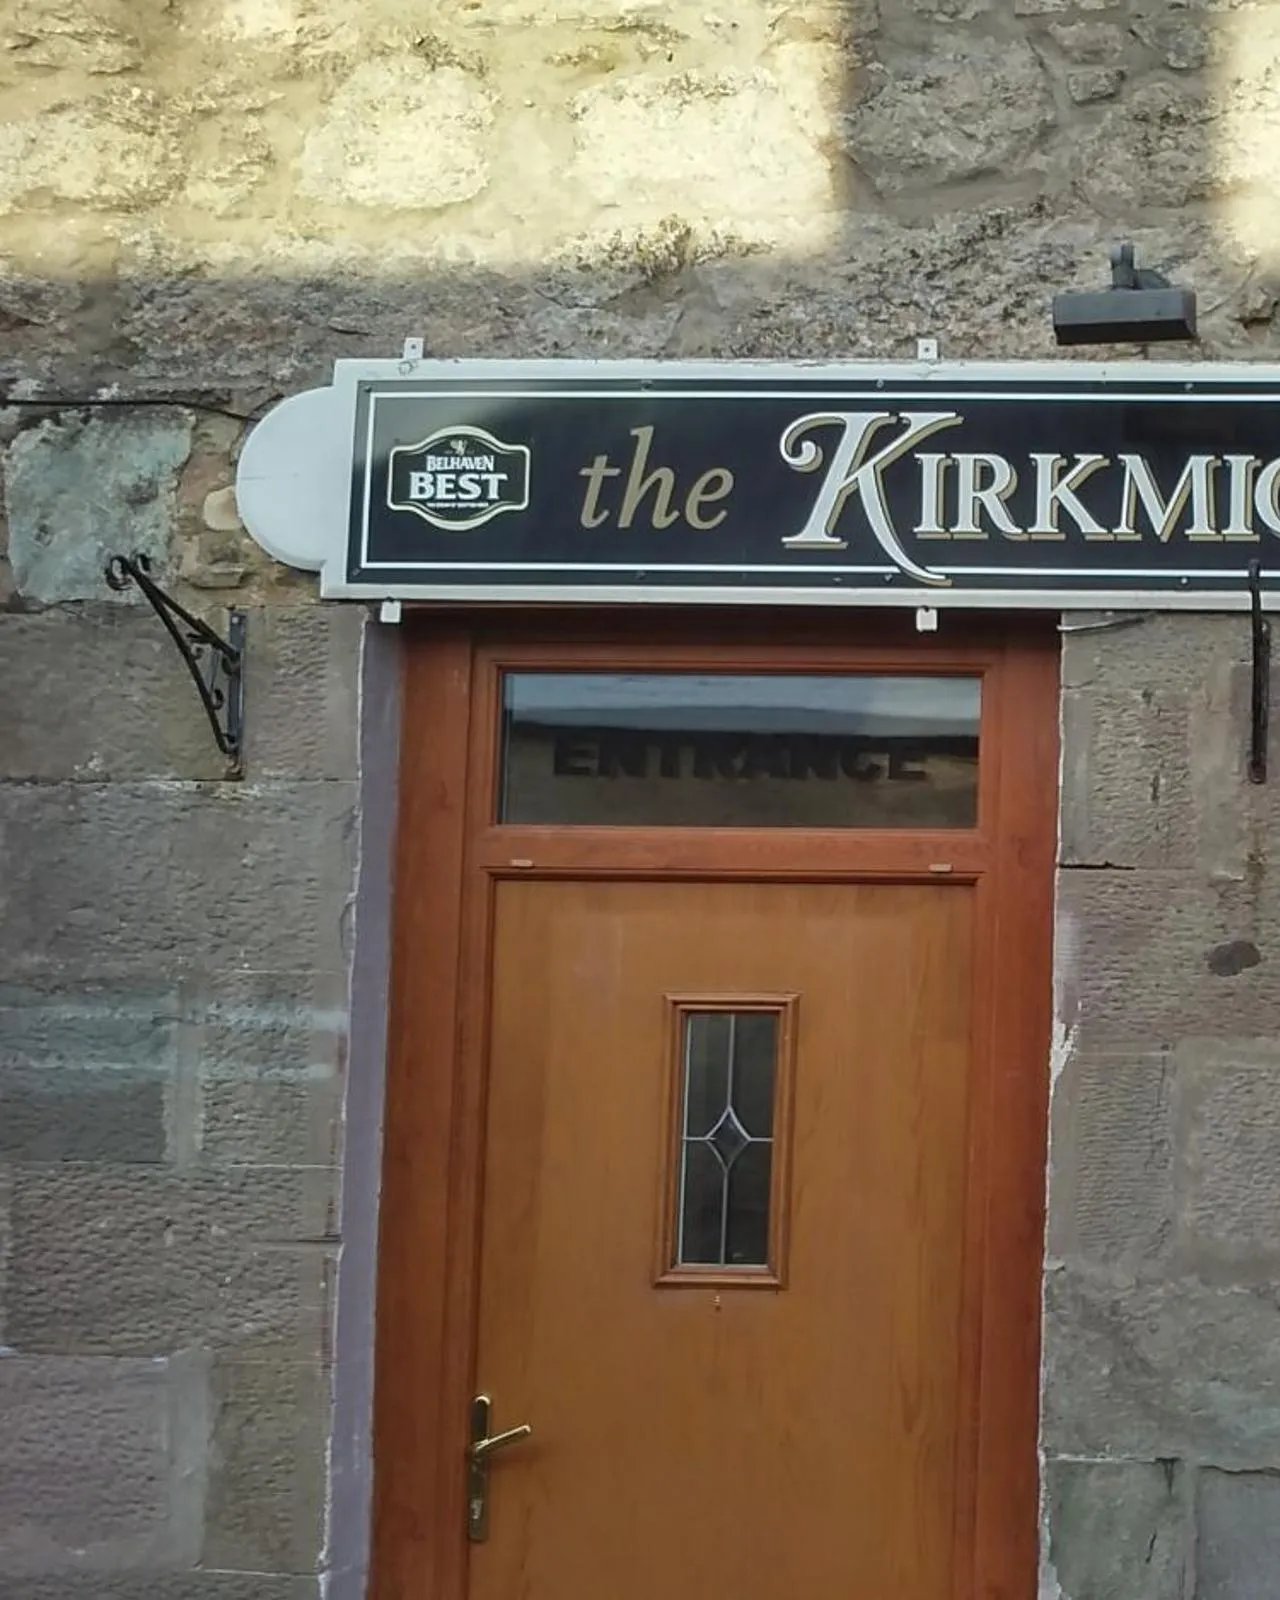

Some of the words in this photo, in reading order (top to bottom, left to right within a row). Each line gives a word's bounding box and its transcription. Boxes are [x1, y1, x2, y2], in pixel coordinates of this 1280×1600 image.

[426, 454, 494, 471] BELHAVEN
[580, 425, 734, 530] the
[409, 471, 508, 500] BEST
[553, 731, 928, 781] ENTRANCE
